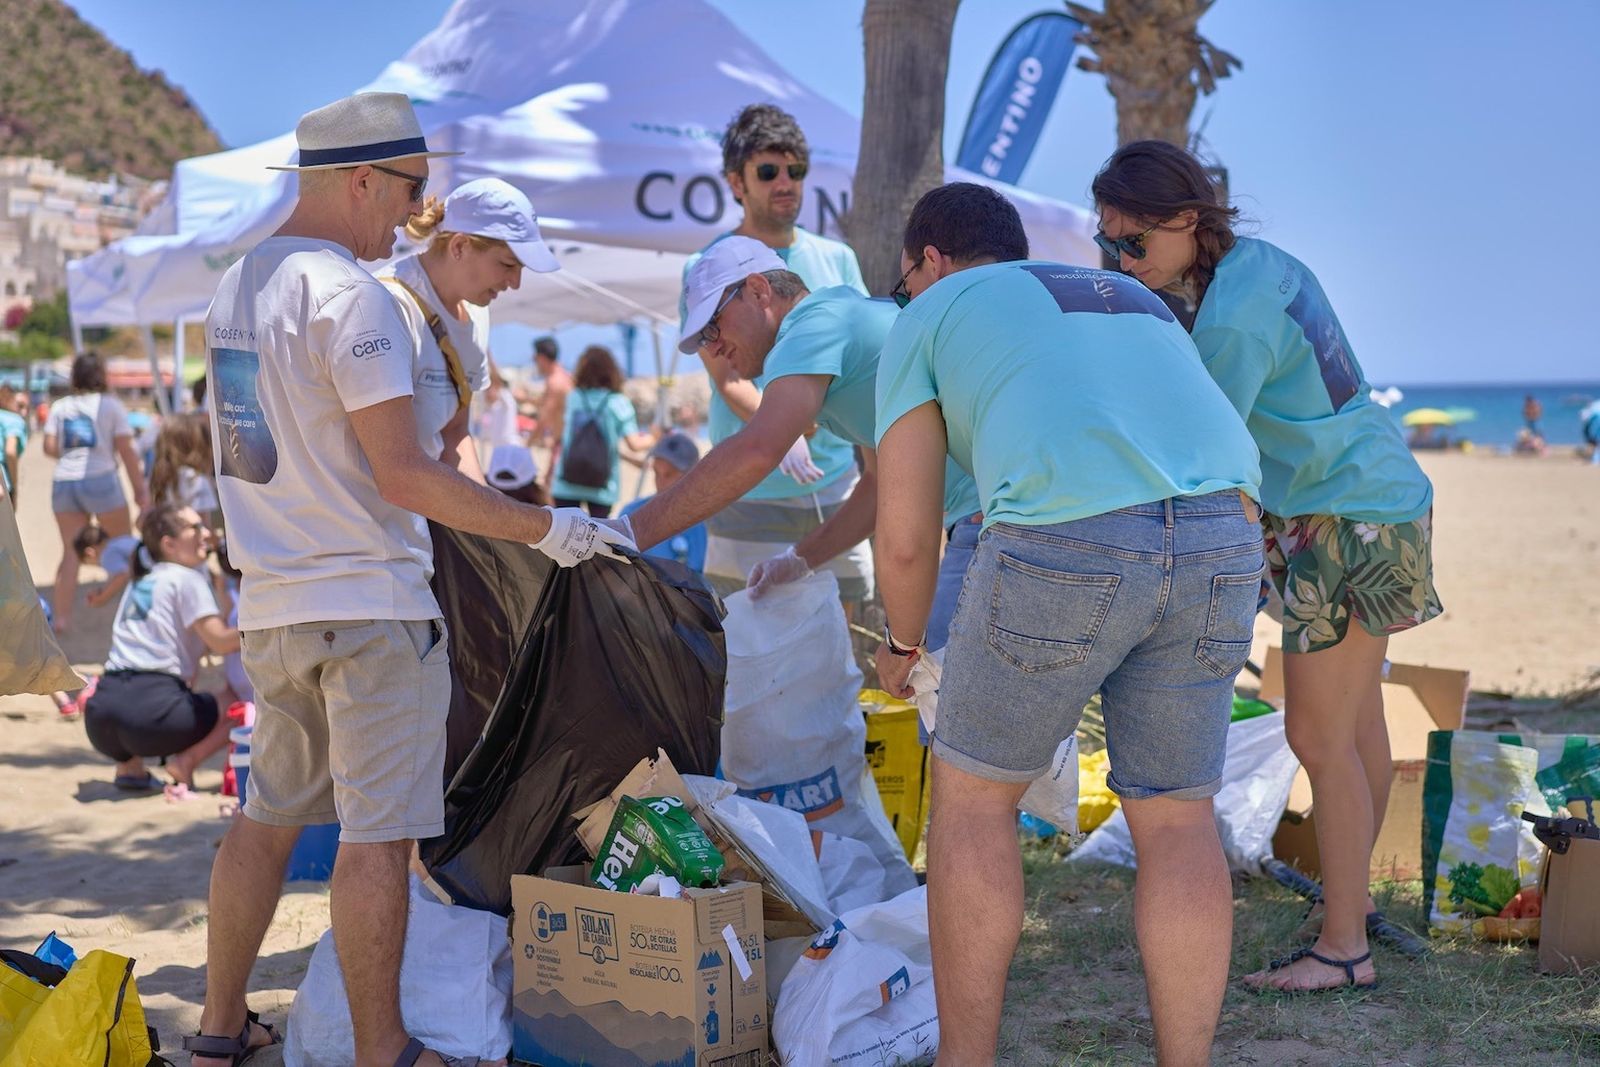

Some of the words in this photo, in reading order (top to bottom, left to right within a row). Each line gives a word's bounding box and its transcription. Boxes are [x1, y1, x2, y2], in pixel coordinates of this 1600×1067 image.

[635, 170, 848, 235] CON
[214, 327, 256, 341] COSENN
[352, 337, 392, 358] care
[234, 404, 246, 413] act
[242, 419, 256, 428] care
[581, 914, 611, 937] SOLAN
[654, 927, 677, 936] HECHA
[582, 932, 591, 943] DE
[650, 935, 657, 943] DE
[657, 936, 677, 945] OTRAS
[650, 944, 678, 953] BOTELLAS
